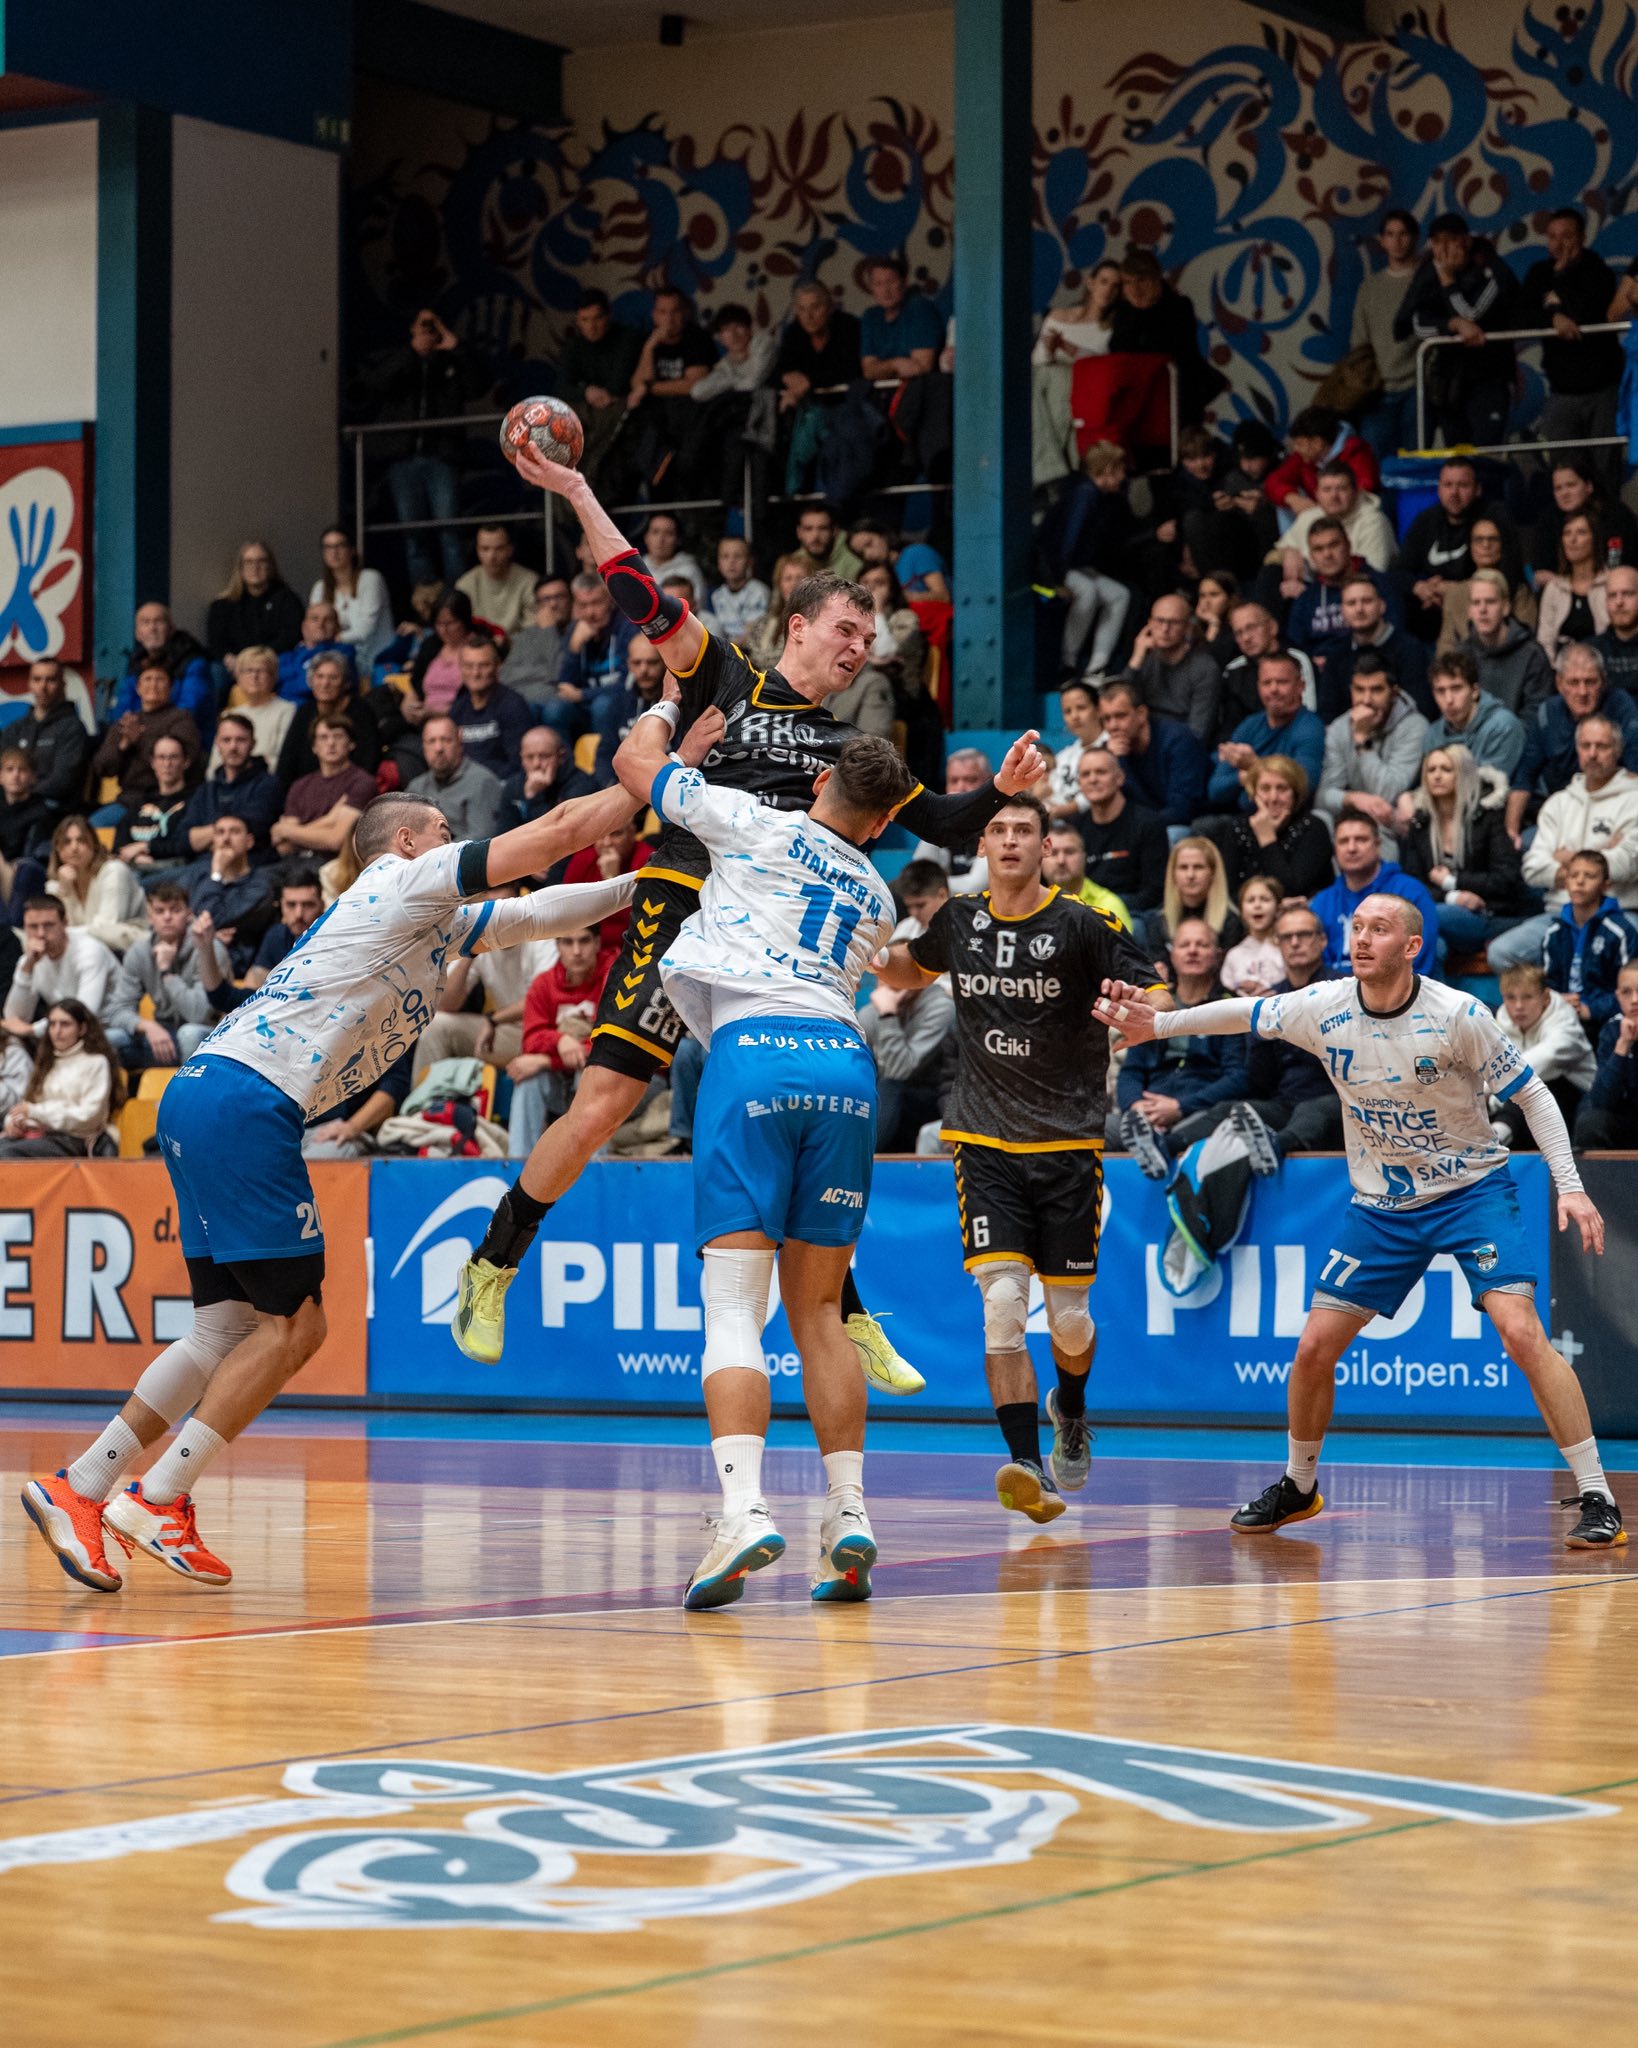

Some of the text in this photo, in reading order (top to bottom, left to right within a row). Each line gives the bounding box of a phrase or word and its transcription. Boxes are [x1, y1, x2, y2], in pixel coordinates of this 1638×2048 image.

[740, 711, 797, 748] 88
[787, 833, 869, 905] ŠTALEKER
[798, 882, 862, 970] 11
[995, 930, 1018, 969] 6
[957, 970, 1062, 1004] gorenje
[1319, 1008, 1353, 1037] ACTIVE
[759, 1033, 842, 1051] KUSTER
[1326, 1046, 1354, 1081] 77
[771, 1094, 856, 1115] KUSTER
[1416, 1155, 1468, 1182] SAVA
[972, 1215, 991, 1249] 6
[1319, 1247, 1362, 1288] 77
